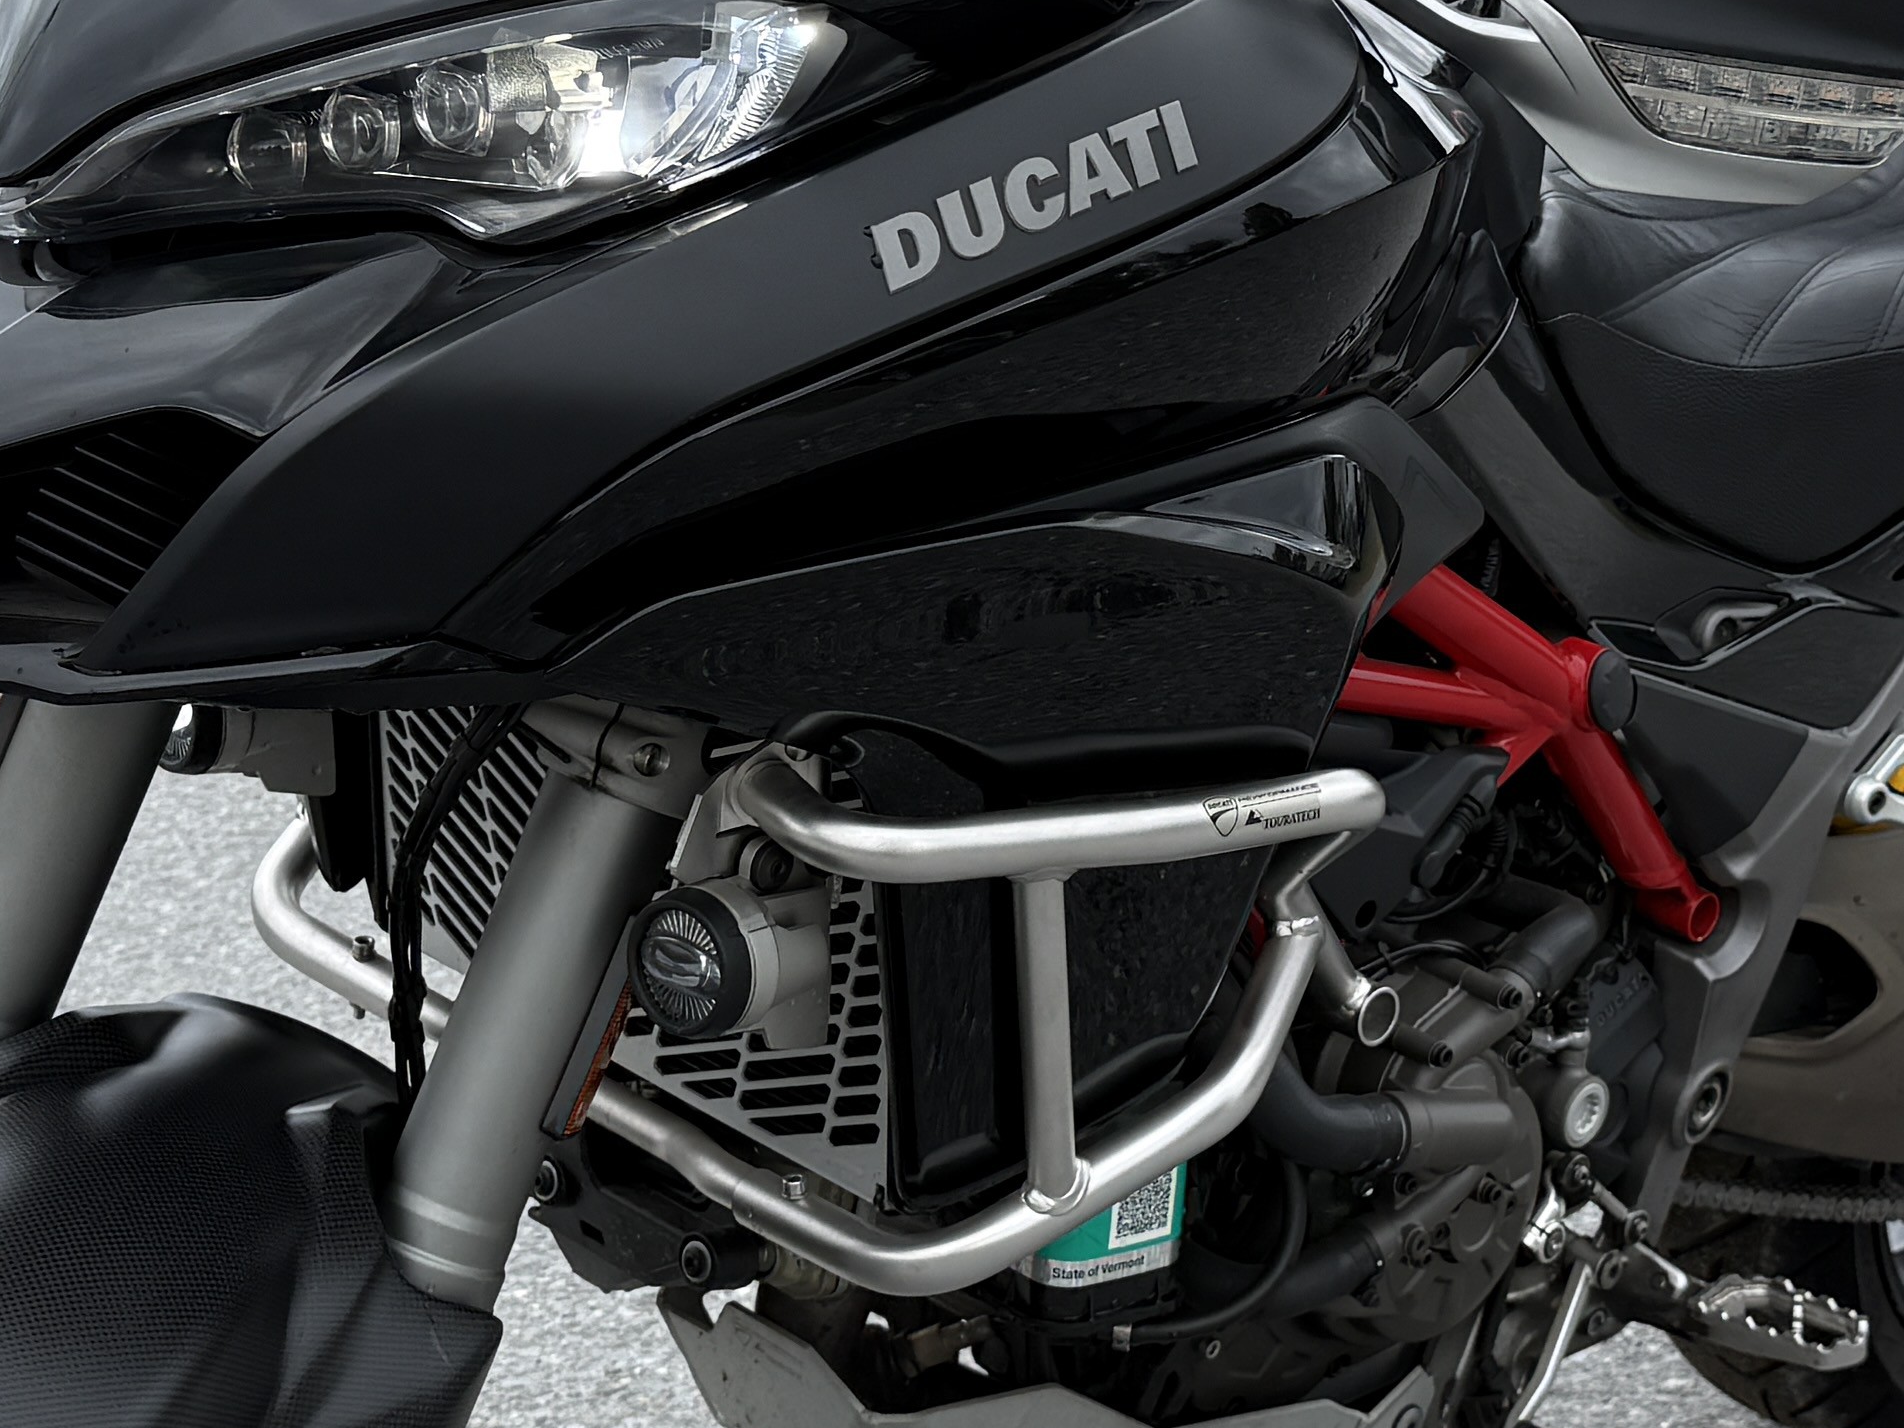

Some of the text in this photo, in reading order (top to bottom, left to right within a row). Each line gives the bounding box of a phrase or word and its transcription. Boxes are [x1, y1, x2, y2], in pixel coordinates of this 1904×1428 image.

[871, 100, 1198, 294] DUCATI
[1263, 808, 1320, 829] TOURATECH
[1052, 1255, 1145, 1279] State of Vermont
